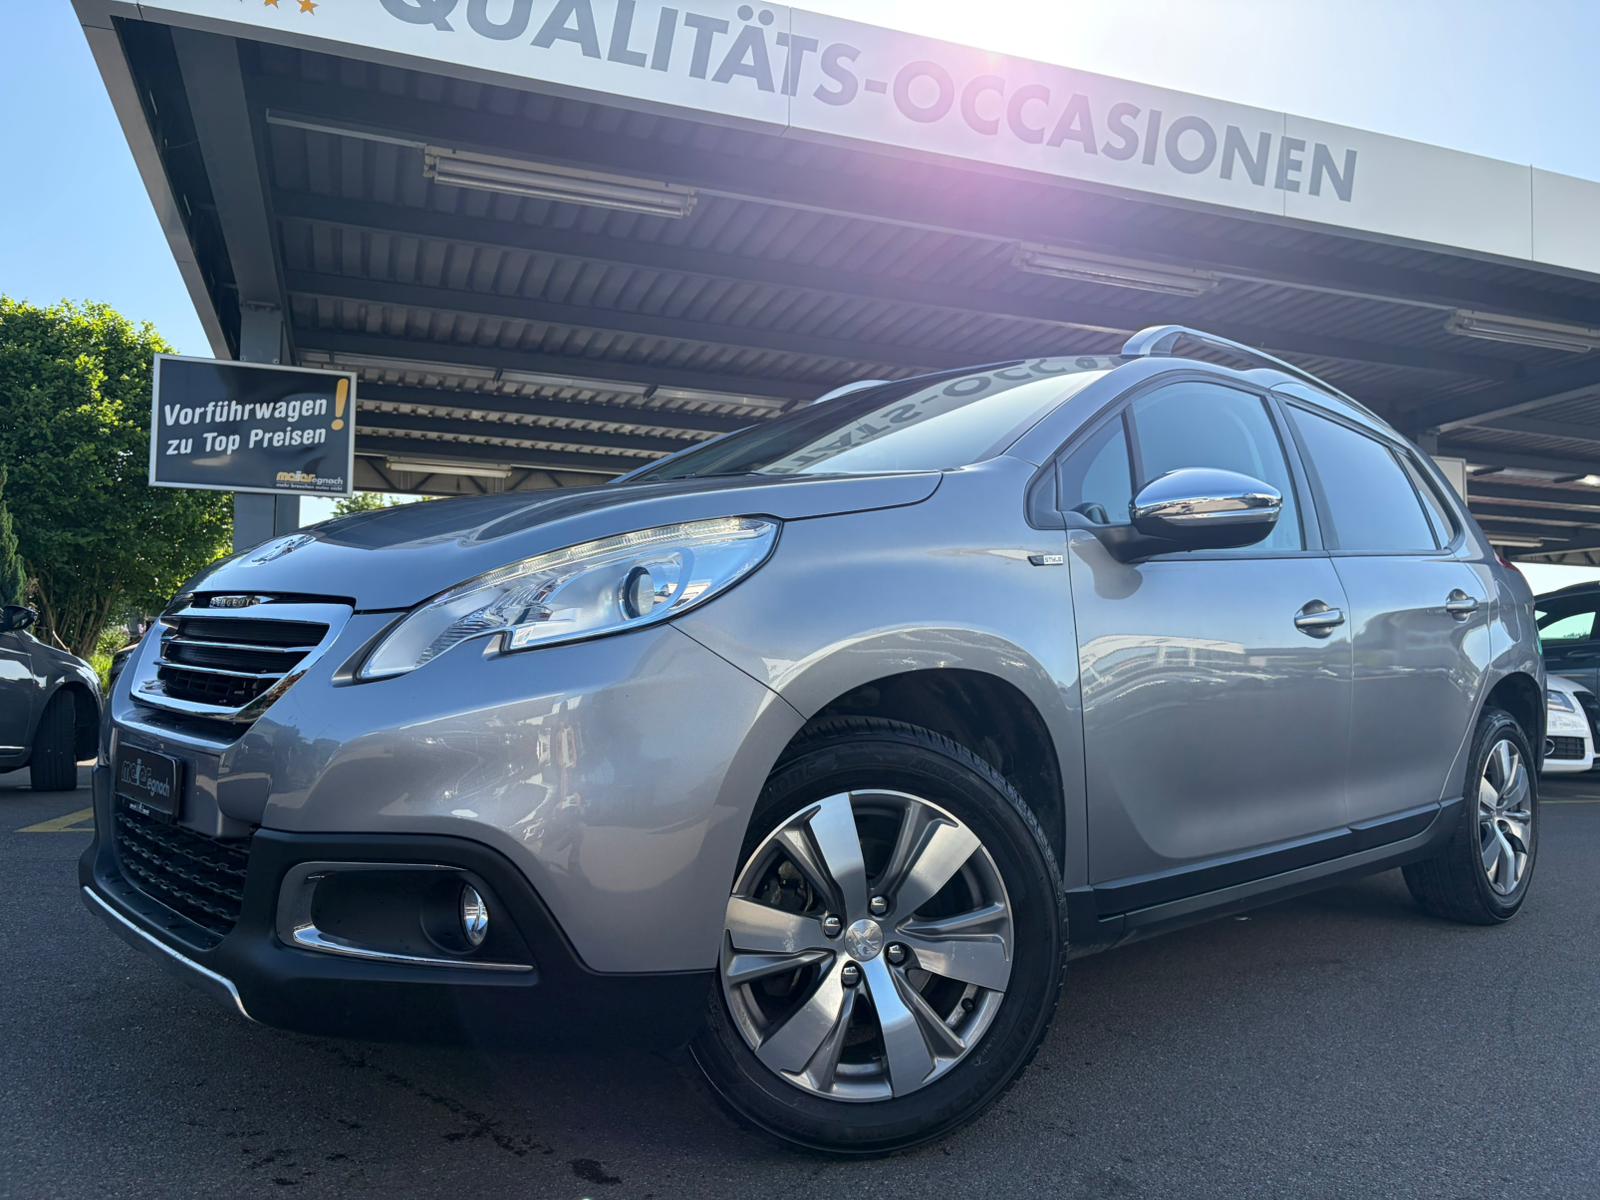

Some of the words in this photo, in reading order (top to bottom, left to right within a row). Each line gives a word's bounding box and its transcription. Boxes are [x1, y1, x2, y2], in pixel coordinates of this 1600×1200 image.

[164, 398, 327, 427] Vorführwagen
[166, 437, 193, 456] zu
[203, 432, 240, 455] Top
[248, 427, 326, 449] Preisen
